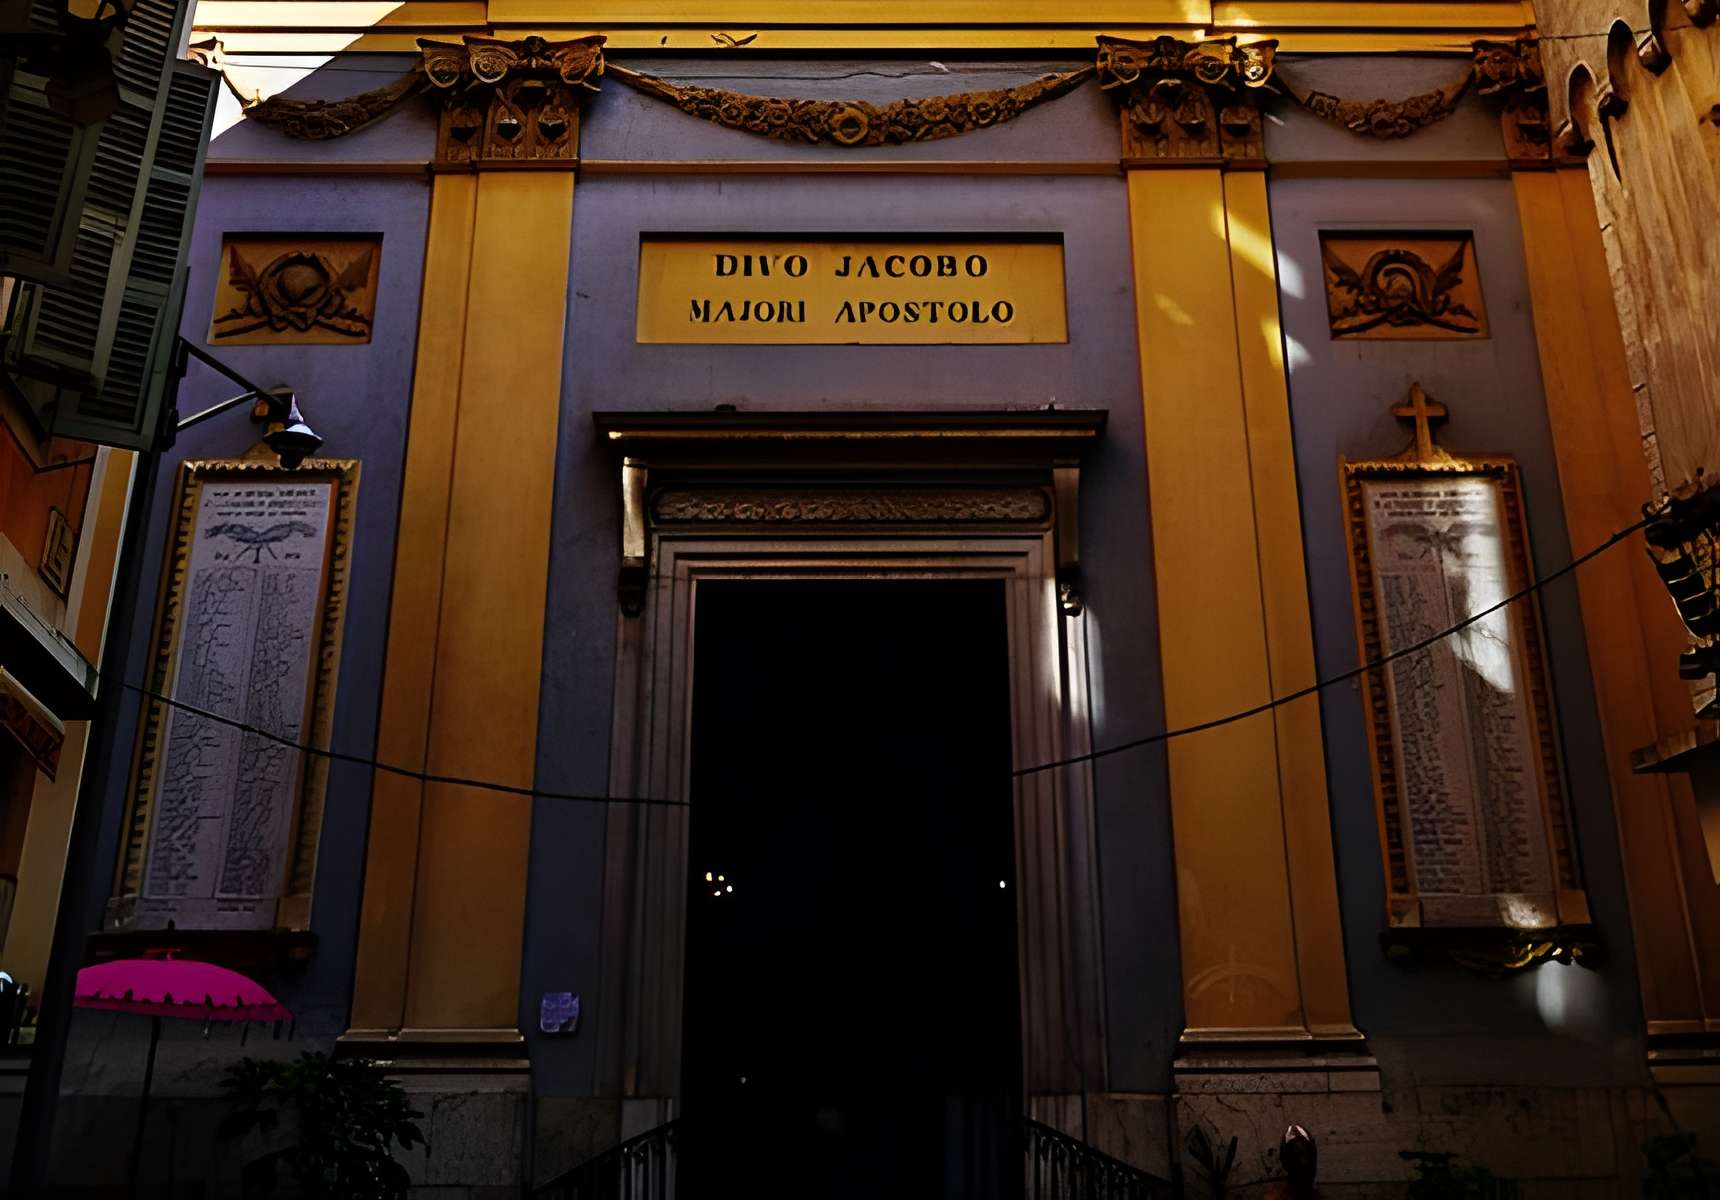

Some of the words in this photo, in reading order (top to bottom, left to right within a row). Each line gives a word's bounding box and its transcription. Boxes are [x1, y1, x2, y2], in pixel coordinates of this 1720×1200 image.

[715, 254, 808, 277] DIVO
[835, 254, 988, 278] JACOBO
[689, 299, 805, 323] MAJORI
[835, 300, 1014, 324] APOSTOLO
